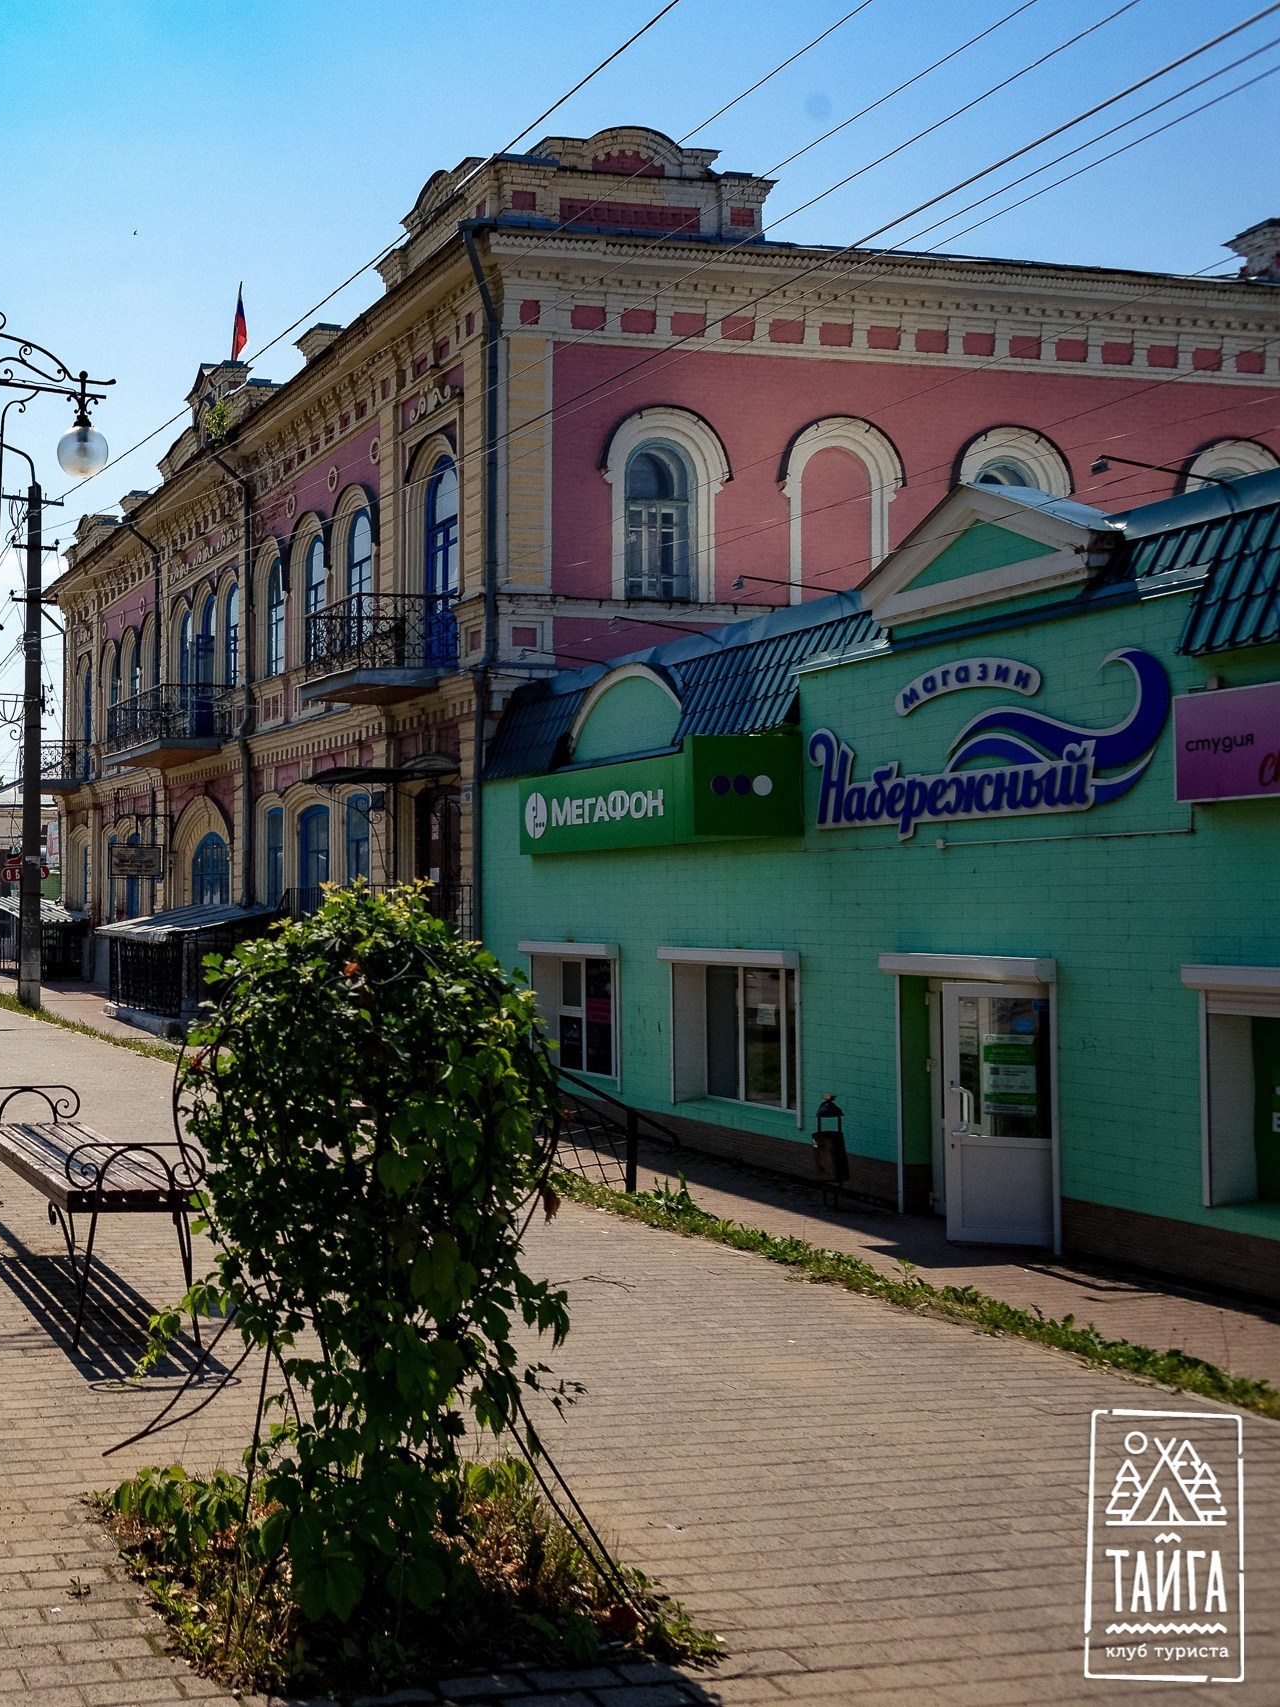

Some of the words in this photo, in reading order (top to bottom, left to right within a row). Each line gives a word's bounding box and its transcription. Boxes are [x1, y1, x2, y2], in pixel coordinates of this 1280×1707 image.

[903, 663, 1031, 709] магазин
[1185, 733, 1254, 754] студия
[809, 732, 1090, 836] Набережный
